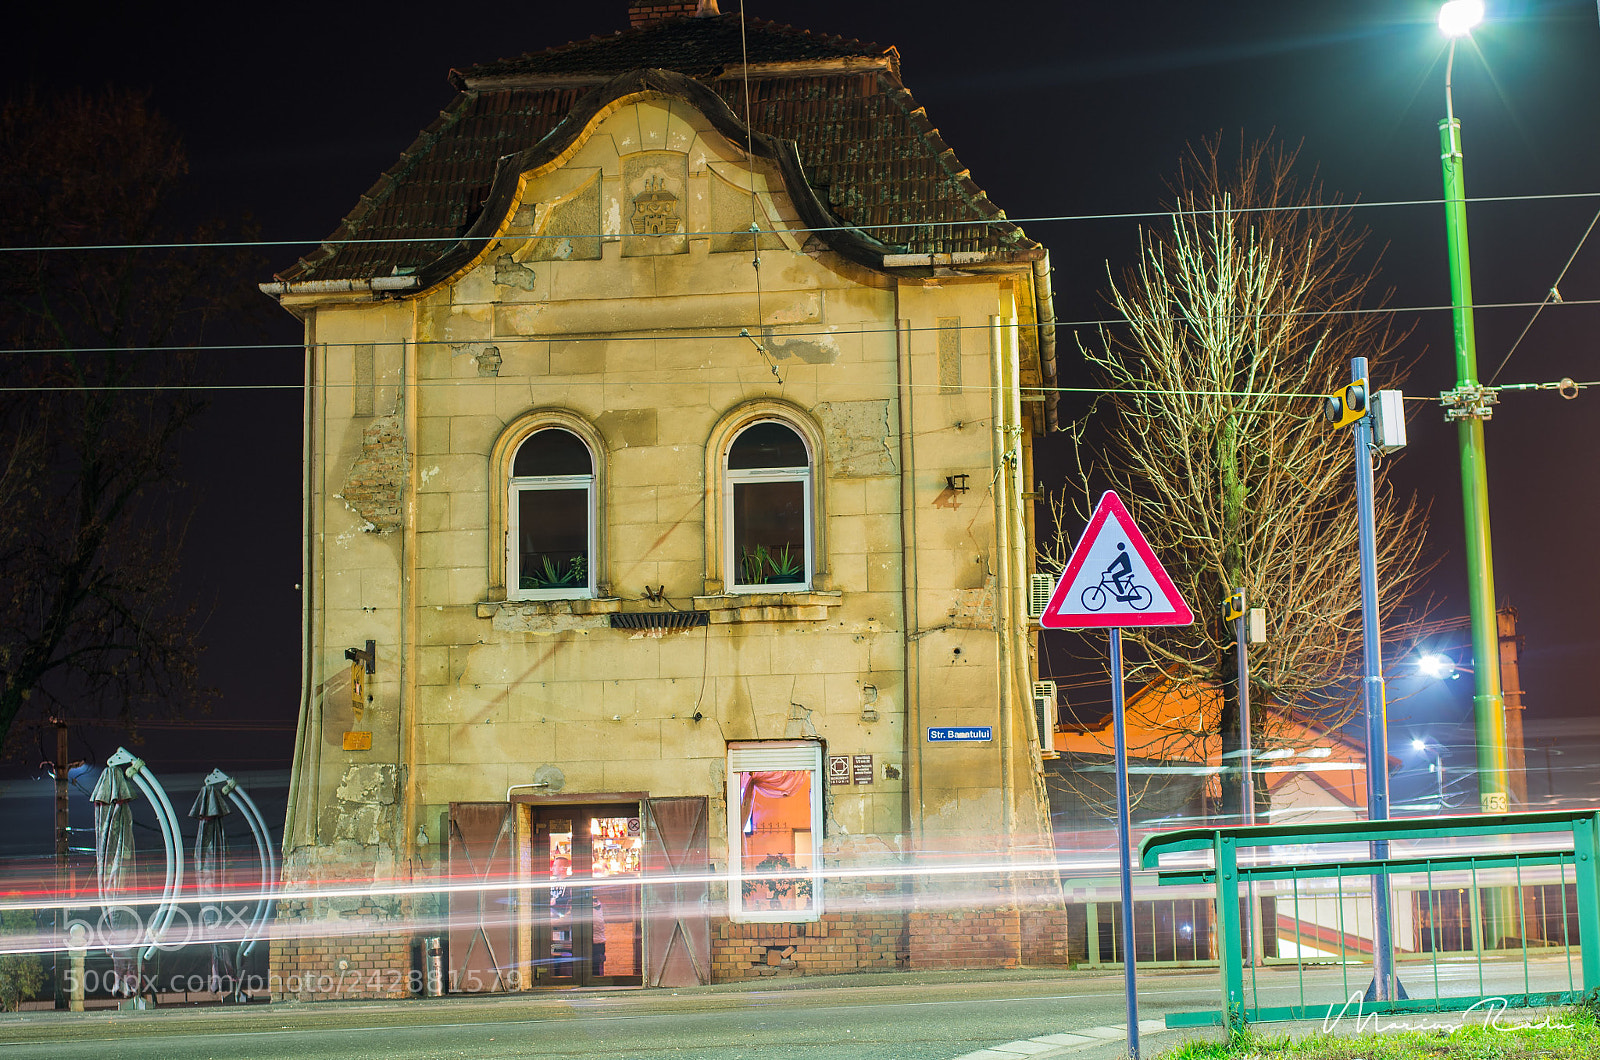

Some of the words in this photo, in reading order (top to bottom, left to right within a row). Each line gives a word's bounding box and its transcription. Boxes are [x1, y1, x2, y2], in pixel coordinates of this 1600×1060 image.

[930, 730, 946, 739] Str.
[947, 730, 990, 739] Baatului
[1481, 795, 1506, 811] 453
